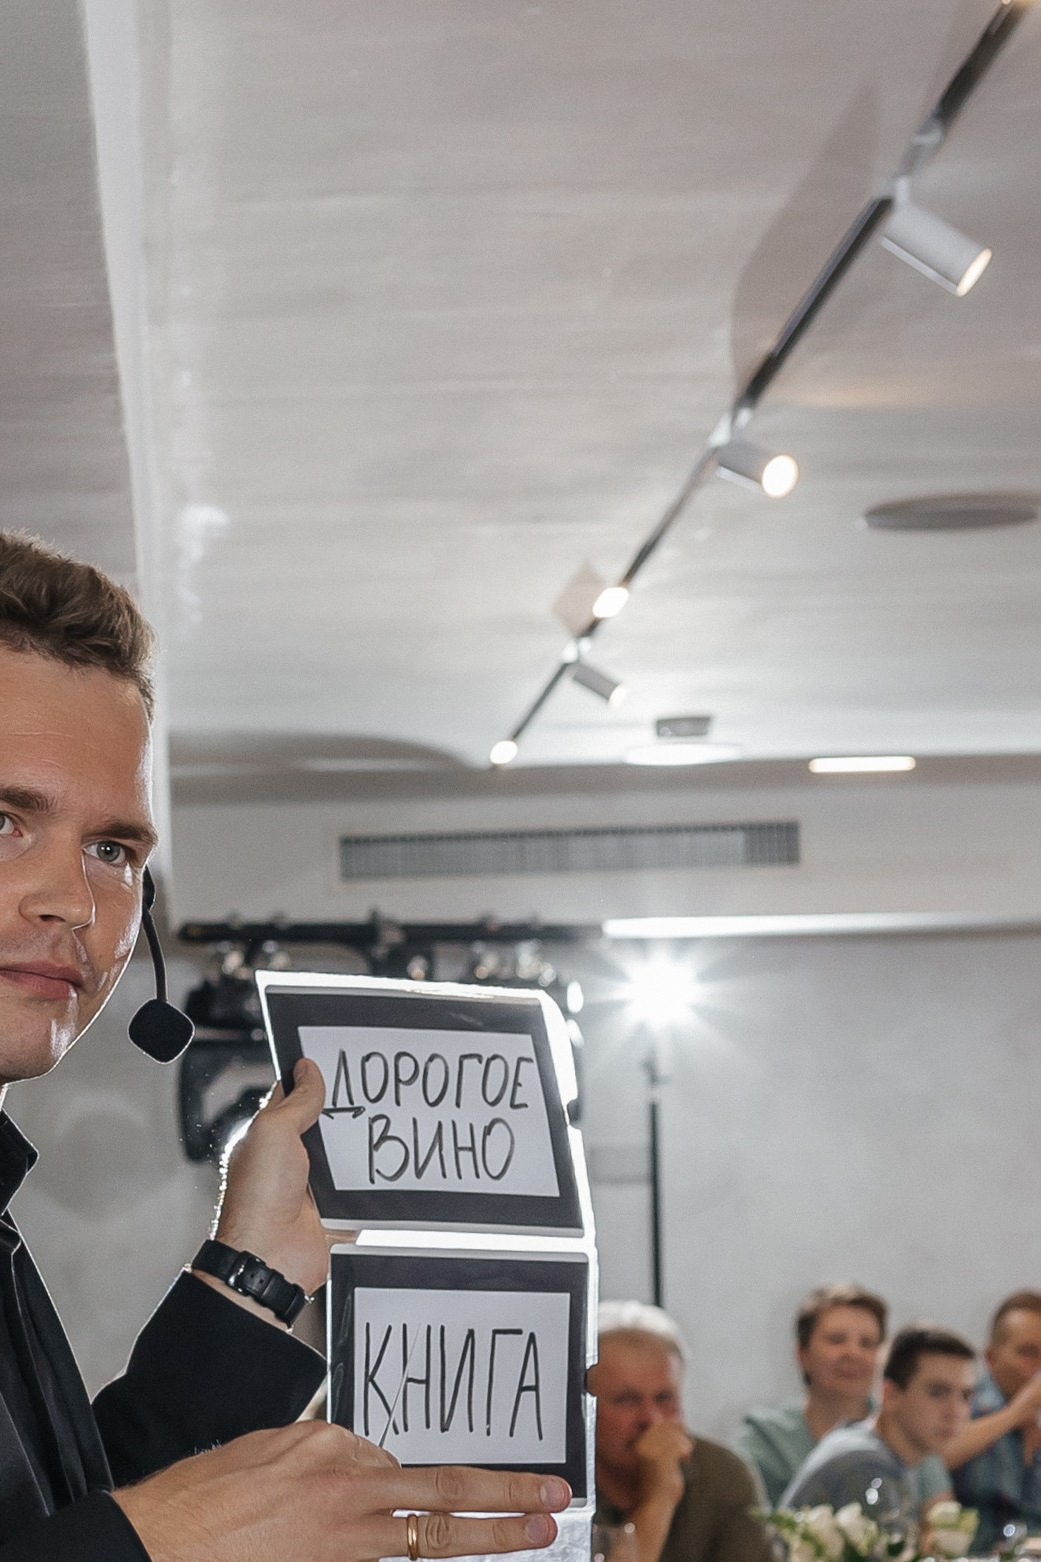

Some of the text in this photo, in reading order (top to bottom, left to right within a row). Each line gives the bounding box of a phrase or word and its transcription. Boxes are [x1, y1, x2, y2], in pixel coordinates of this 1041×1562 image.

[322, 1048, 534, 1119] ДОРОГОЕ
[367, 1113, 515, 1184] ВИНО
[363, 1321, 544, 1441] КНИГА
